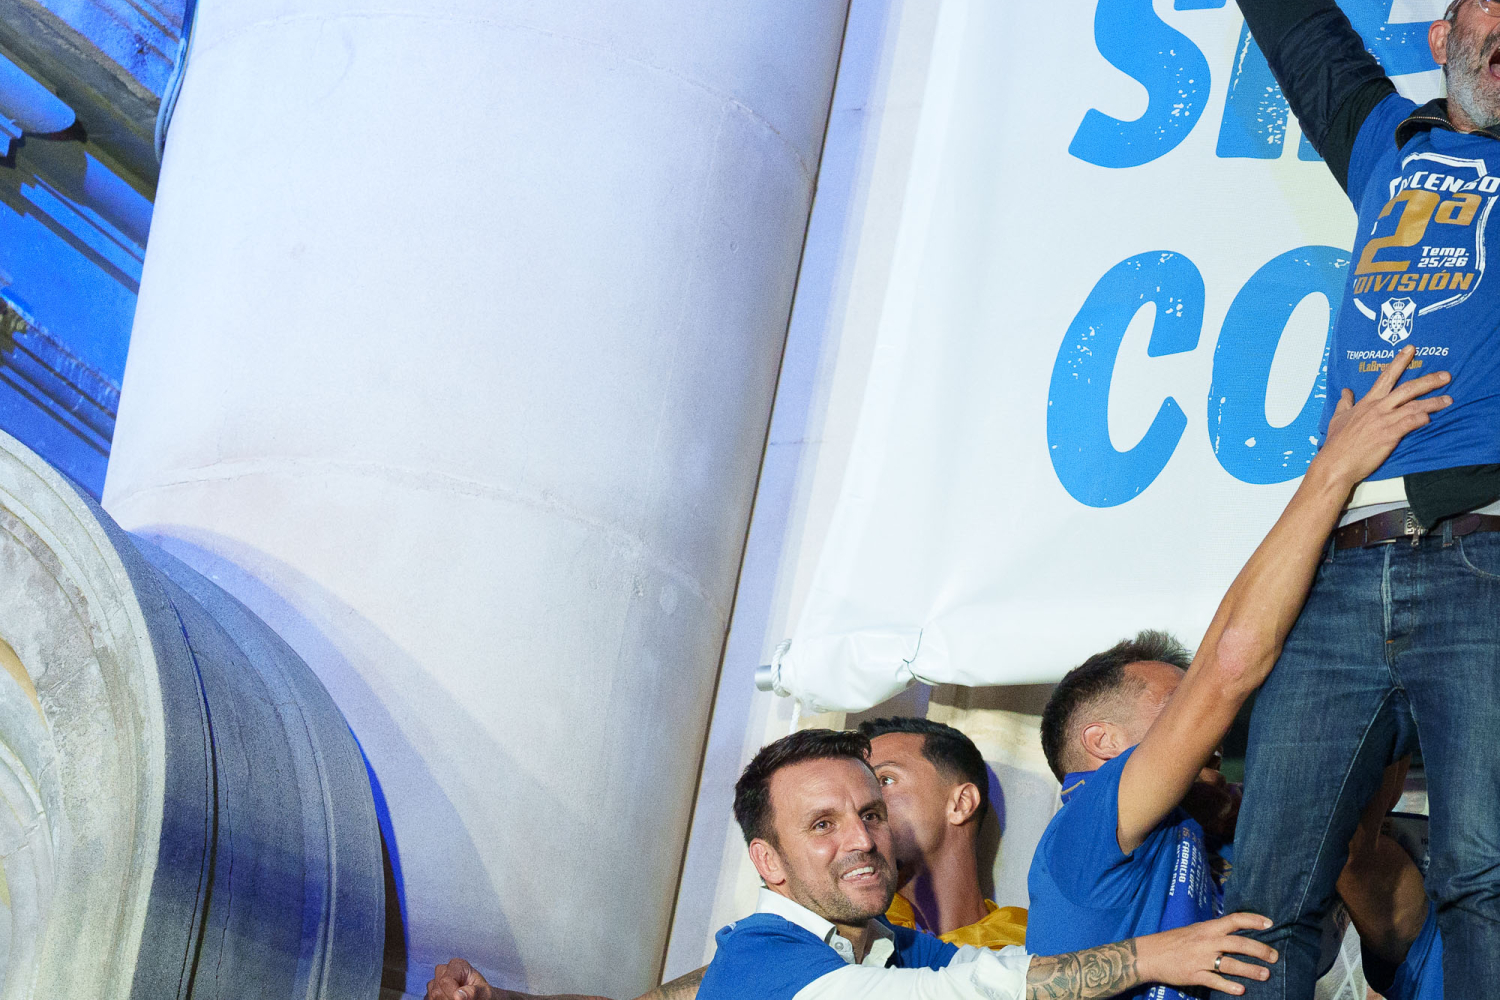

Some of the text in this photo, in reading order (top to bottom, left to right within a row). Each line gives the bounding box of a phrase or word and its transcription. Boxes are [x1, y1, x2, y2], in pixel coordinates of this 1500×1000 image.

[1422, 246, 1469, 257] Temp.
[1417, 257, 1469, 268] 25/26
[1354, 269, 1474, 294] DIVISIÓN
[1346, 346, 1449, 360] TEMPORADA 5/2026
[1179, 841, 1190, 883] FABRICIO
